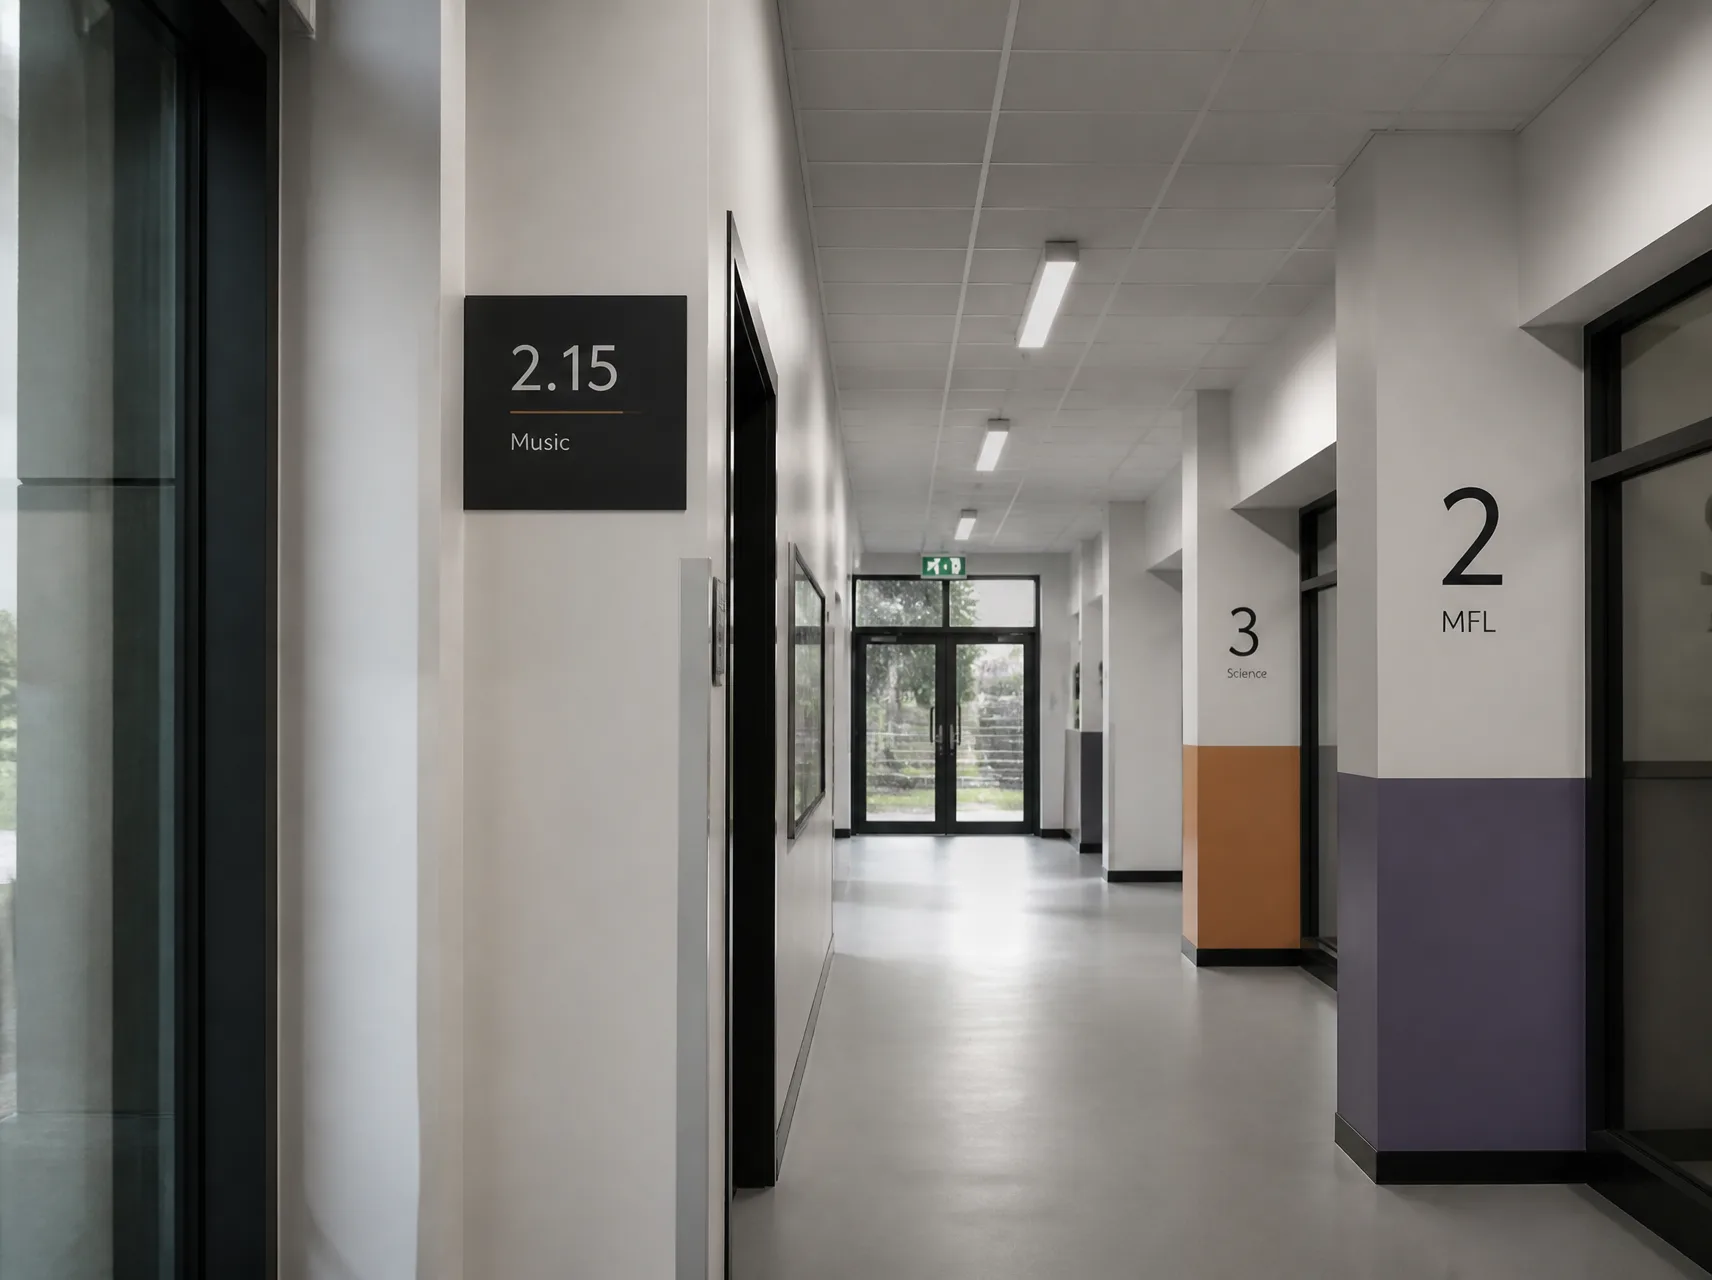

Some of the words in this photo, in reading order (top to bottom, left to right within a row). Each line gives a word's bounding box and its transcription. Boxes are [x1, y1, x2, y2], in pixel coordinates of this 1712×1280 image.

[512, 345, 617, 391] 2.15
[512, 433, 569, 450] Music
[1442, 487, 1502, 585] 2
[1229, 607, 1258, 656] 3
[1443, 611, 1496, 632] MFL
[1227, 667, 1268, 679] Science
